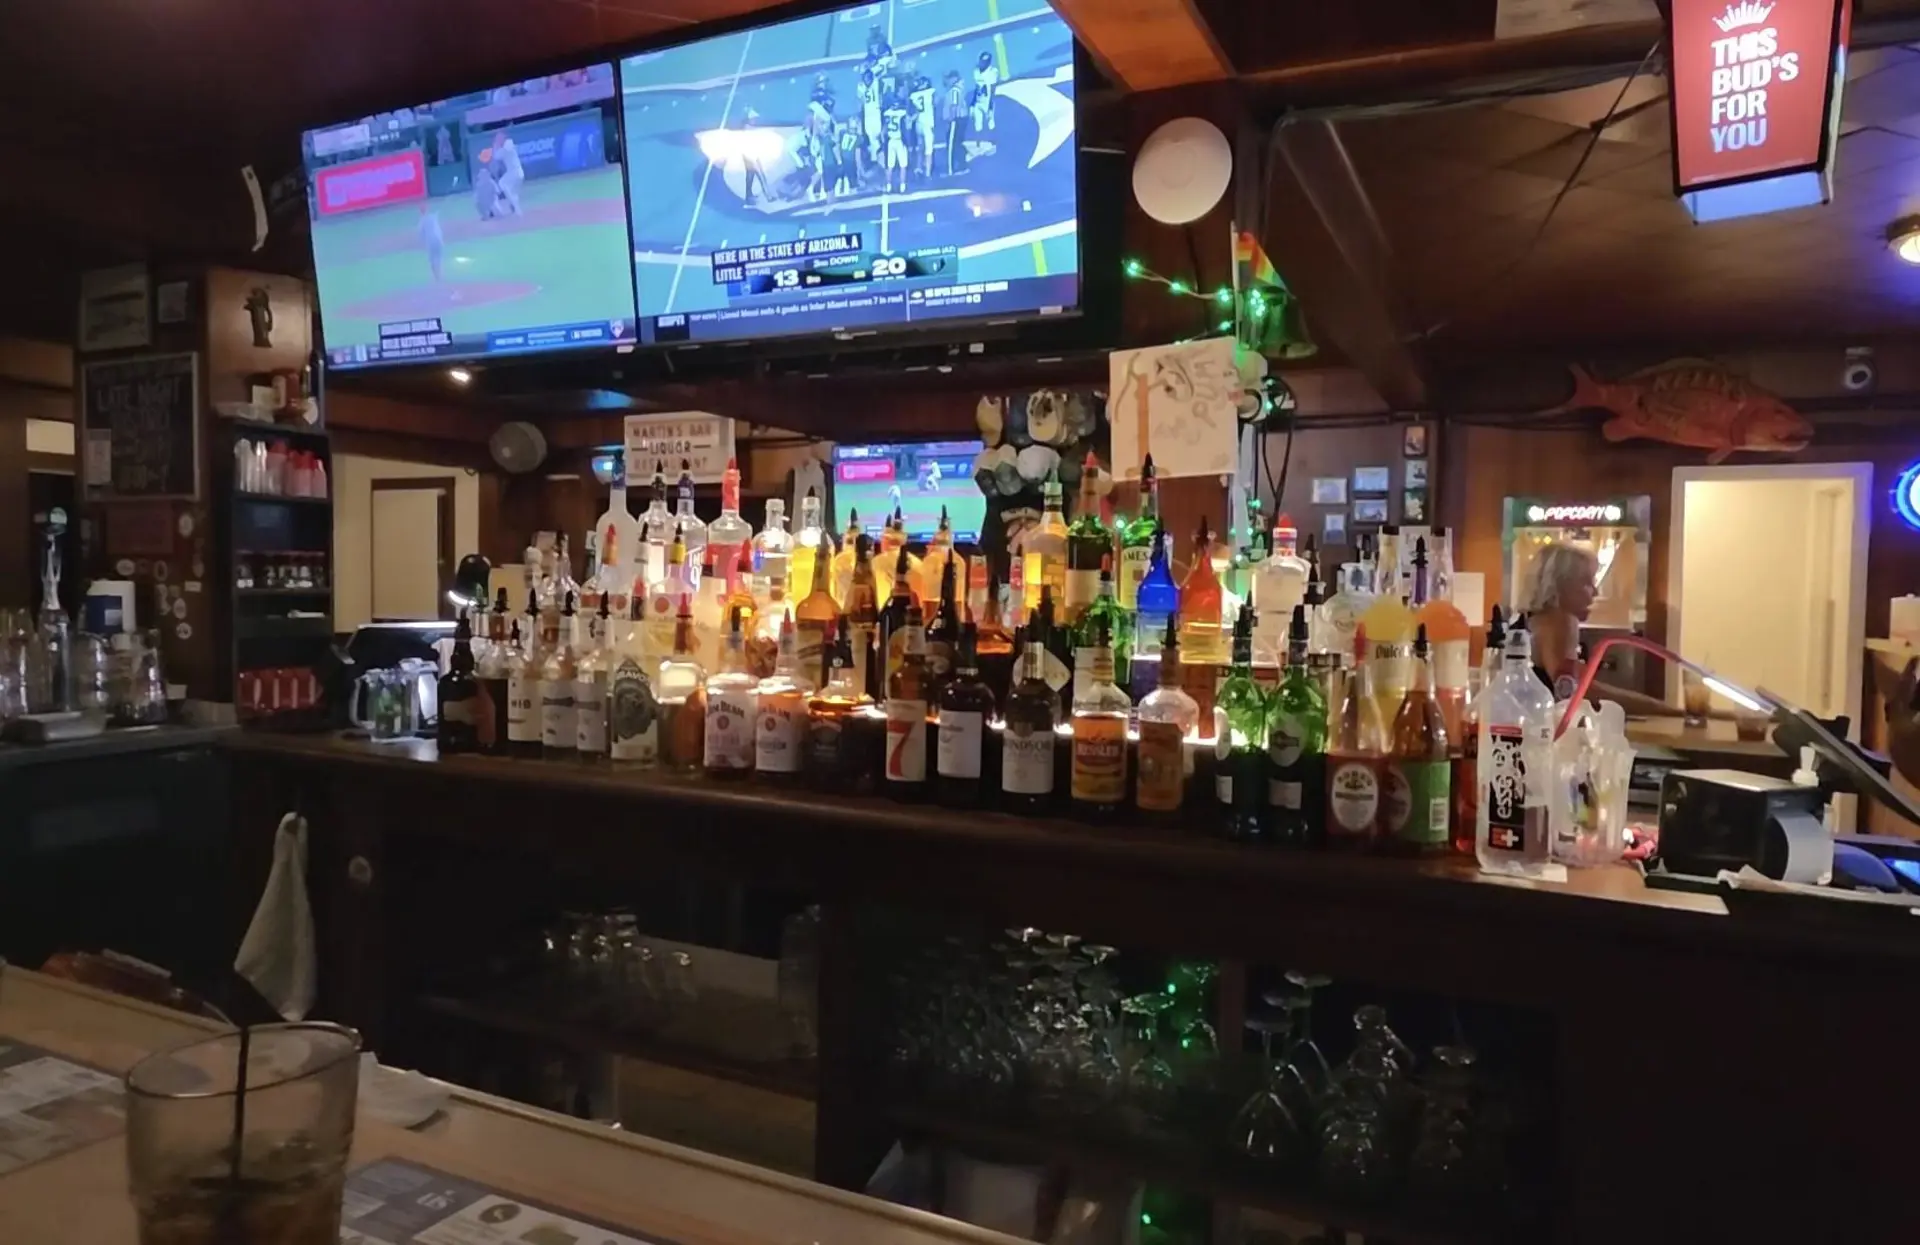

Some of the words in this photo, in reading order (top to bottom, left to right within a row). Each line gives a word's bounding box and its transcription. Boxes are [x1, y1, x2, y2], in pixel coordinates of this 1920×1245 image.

[1711, 28, 1777, 67] THIS
[1712, 52, 1799, 97] BUD'S
[1711, 90, 1767, 124] FOR
[1710, 118, 1767, 153] YOU
[714, 251, 737, 266] HERE
[738, 250, 749, 262] IN
[750, 248, 766, 261] THE
[767, 245, 793, 258] STATE
[794, 242, 807, 256] OF
[851, 235, 859, 249] A
[830, 255, 859, 266] DOWN
[715, 267, 743, 283] LITTLE
[773, 269, 799, 287] 13
[872, 257, 907, 276] 20
[650, 441, 691, 455] LIQUOR
[1543, 505, 1606, 521] POPCORN
[886, 720, 916, 778] 7
